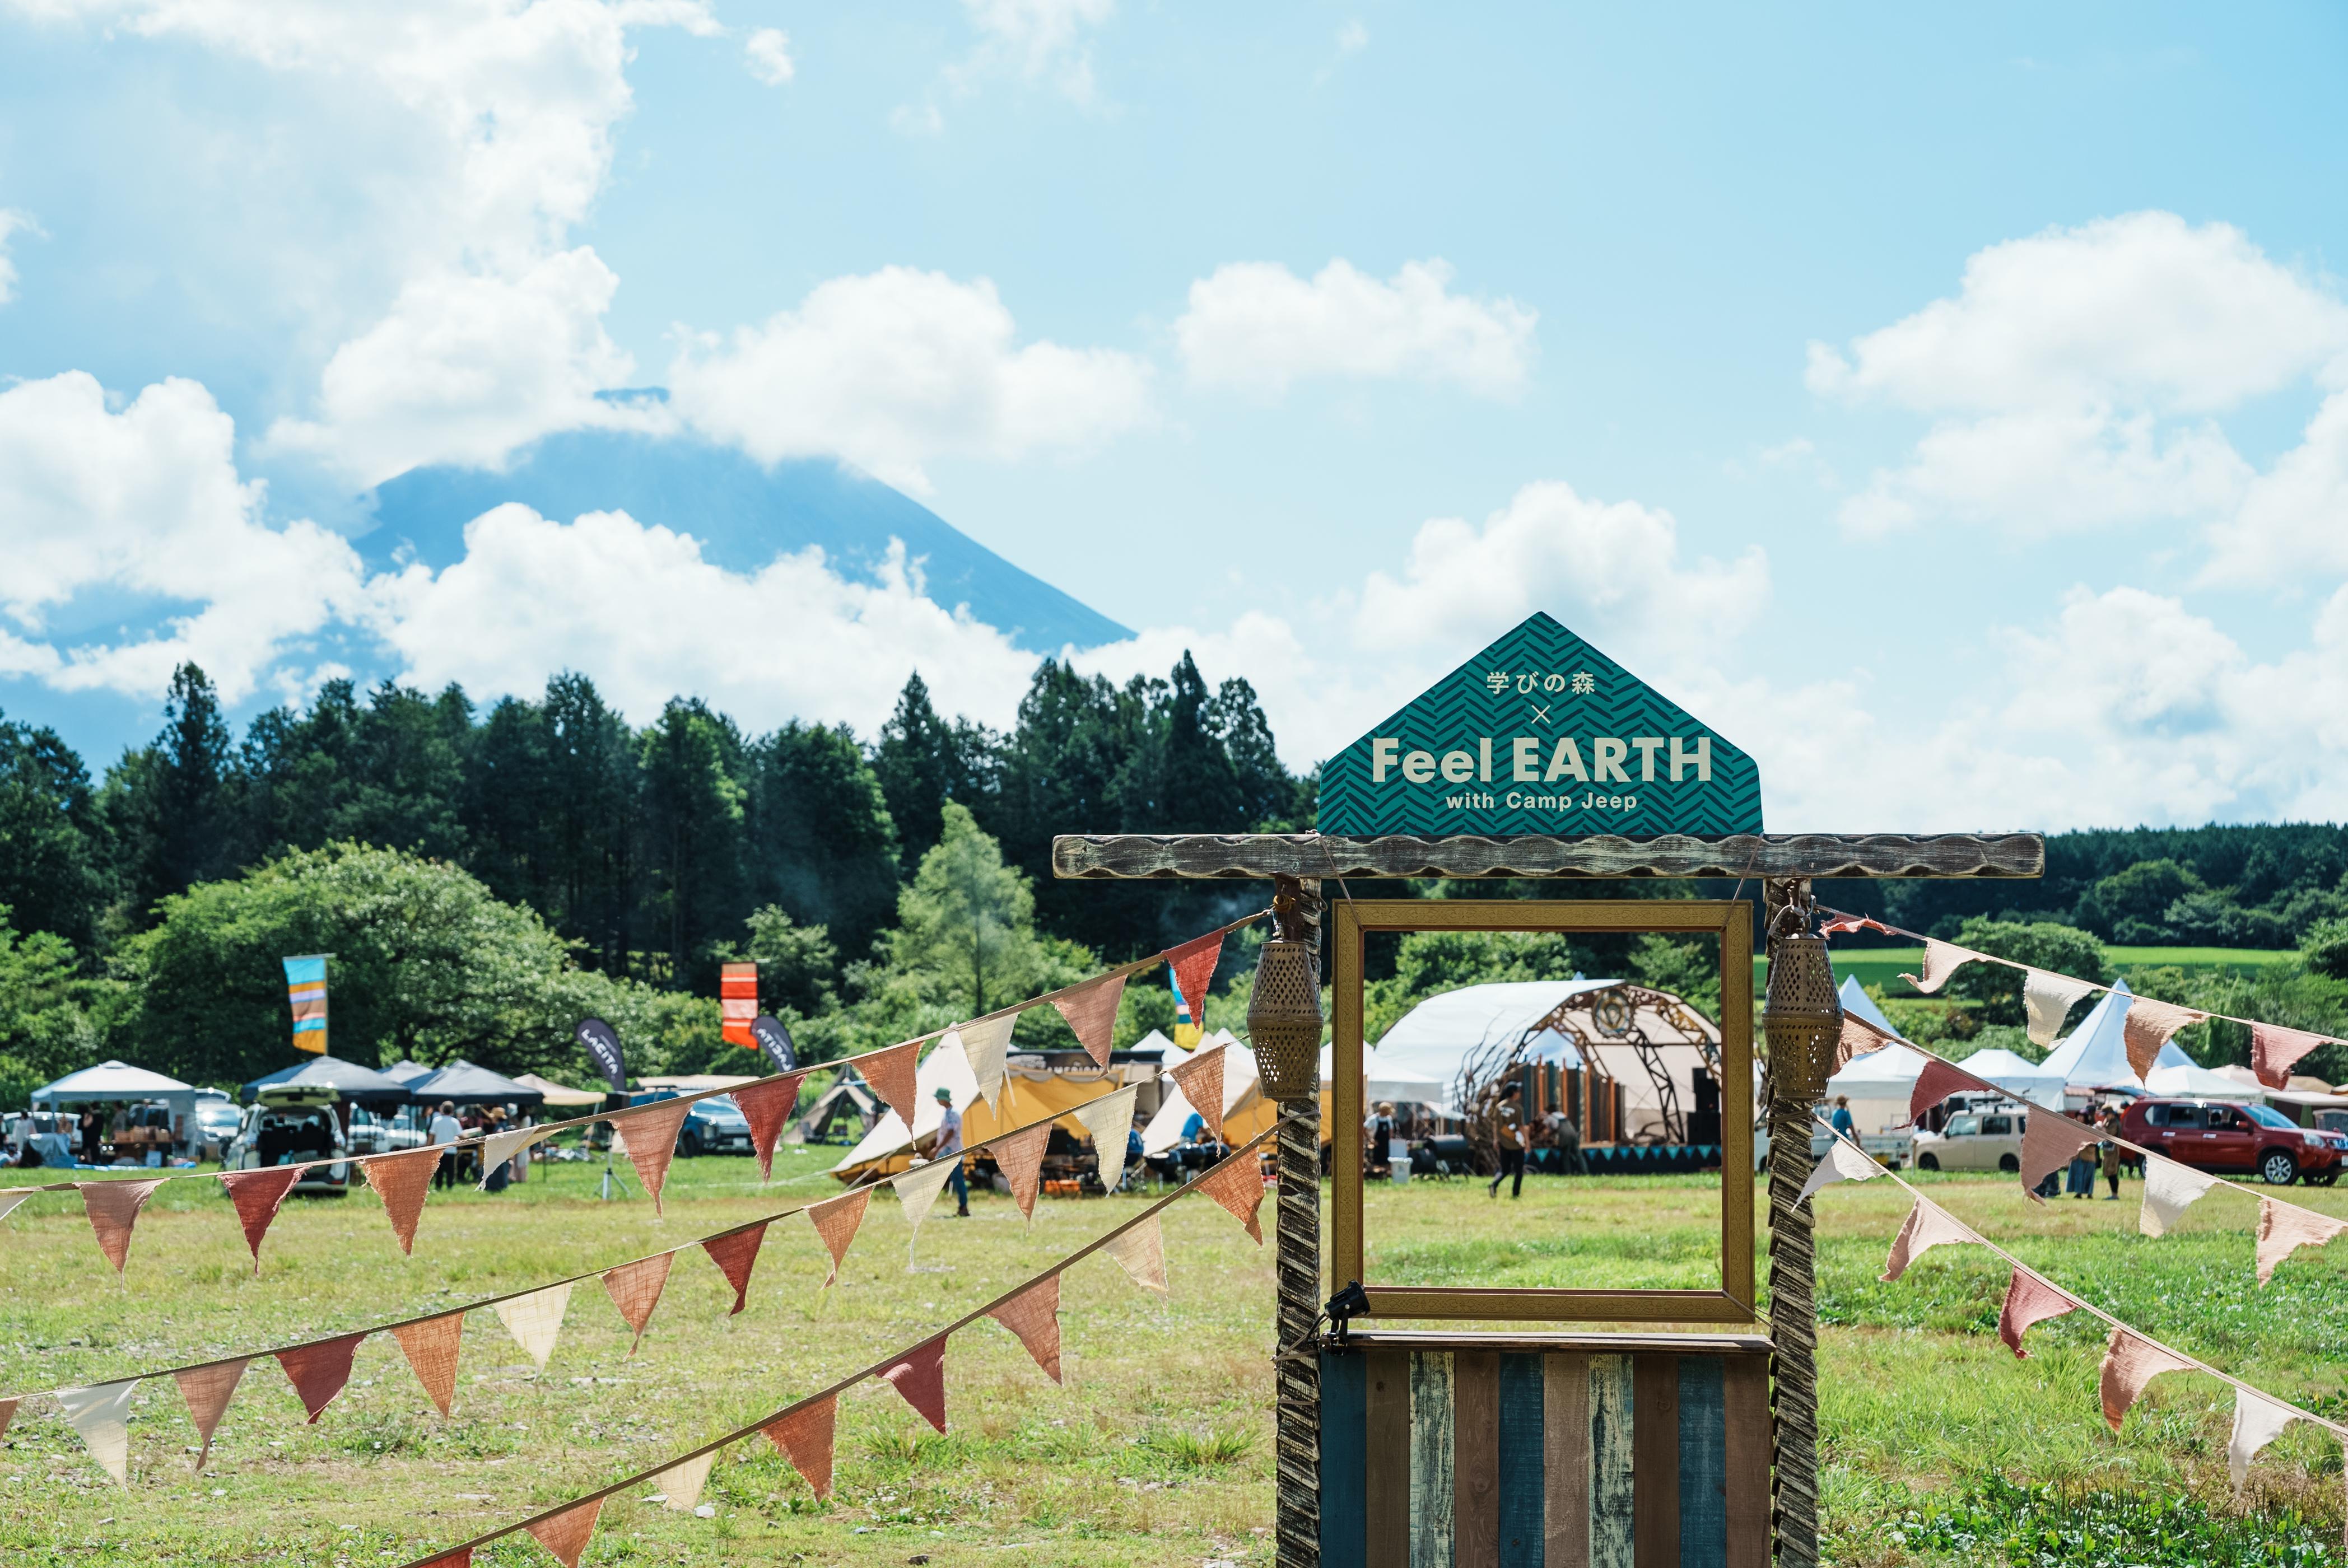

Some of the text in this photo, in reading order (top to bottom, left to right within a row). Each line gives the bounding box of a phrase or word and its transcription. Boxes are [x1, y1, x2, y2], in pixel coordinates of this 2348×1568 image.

[1487, 671, 1595, 694] 学びの森
[1372, 736, 1711, 783] Feel EARTH
[1446, 791, 1637, 812] with Camp Jeep
[581, 1029, 618, 1075] LACITA
